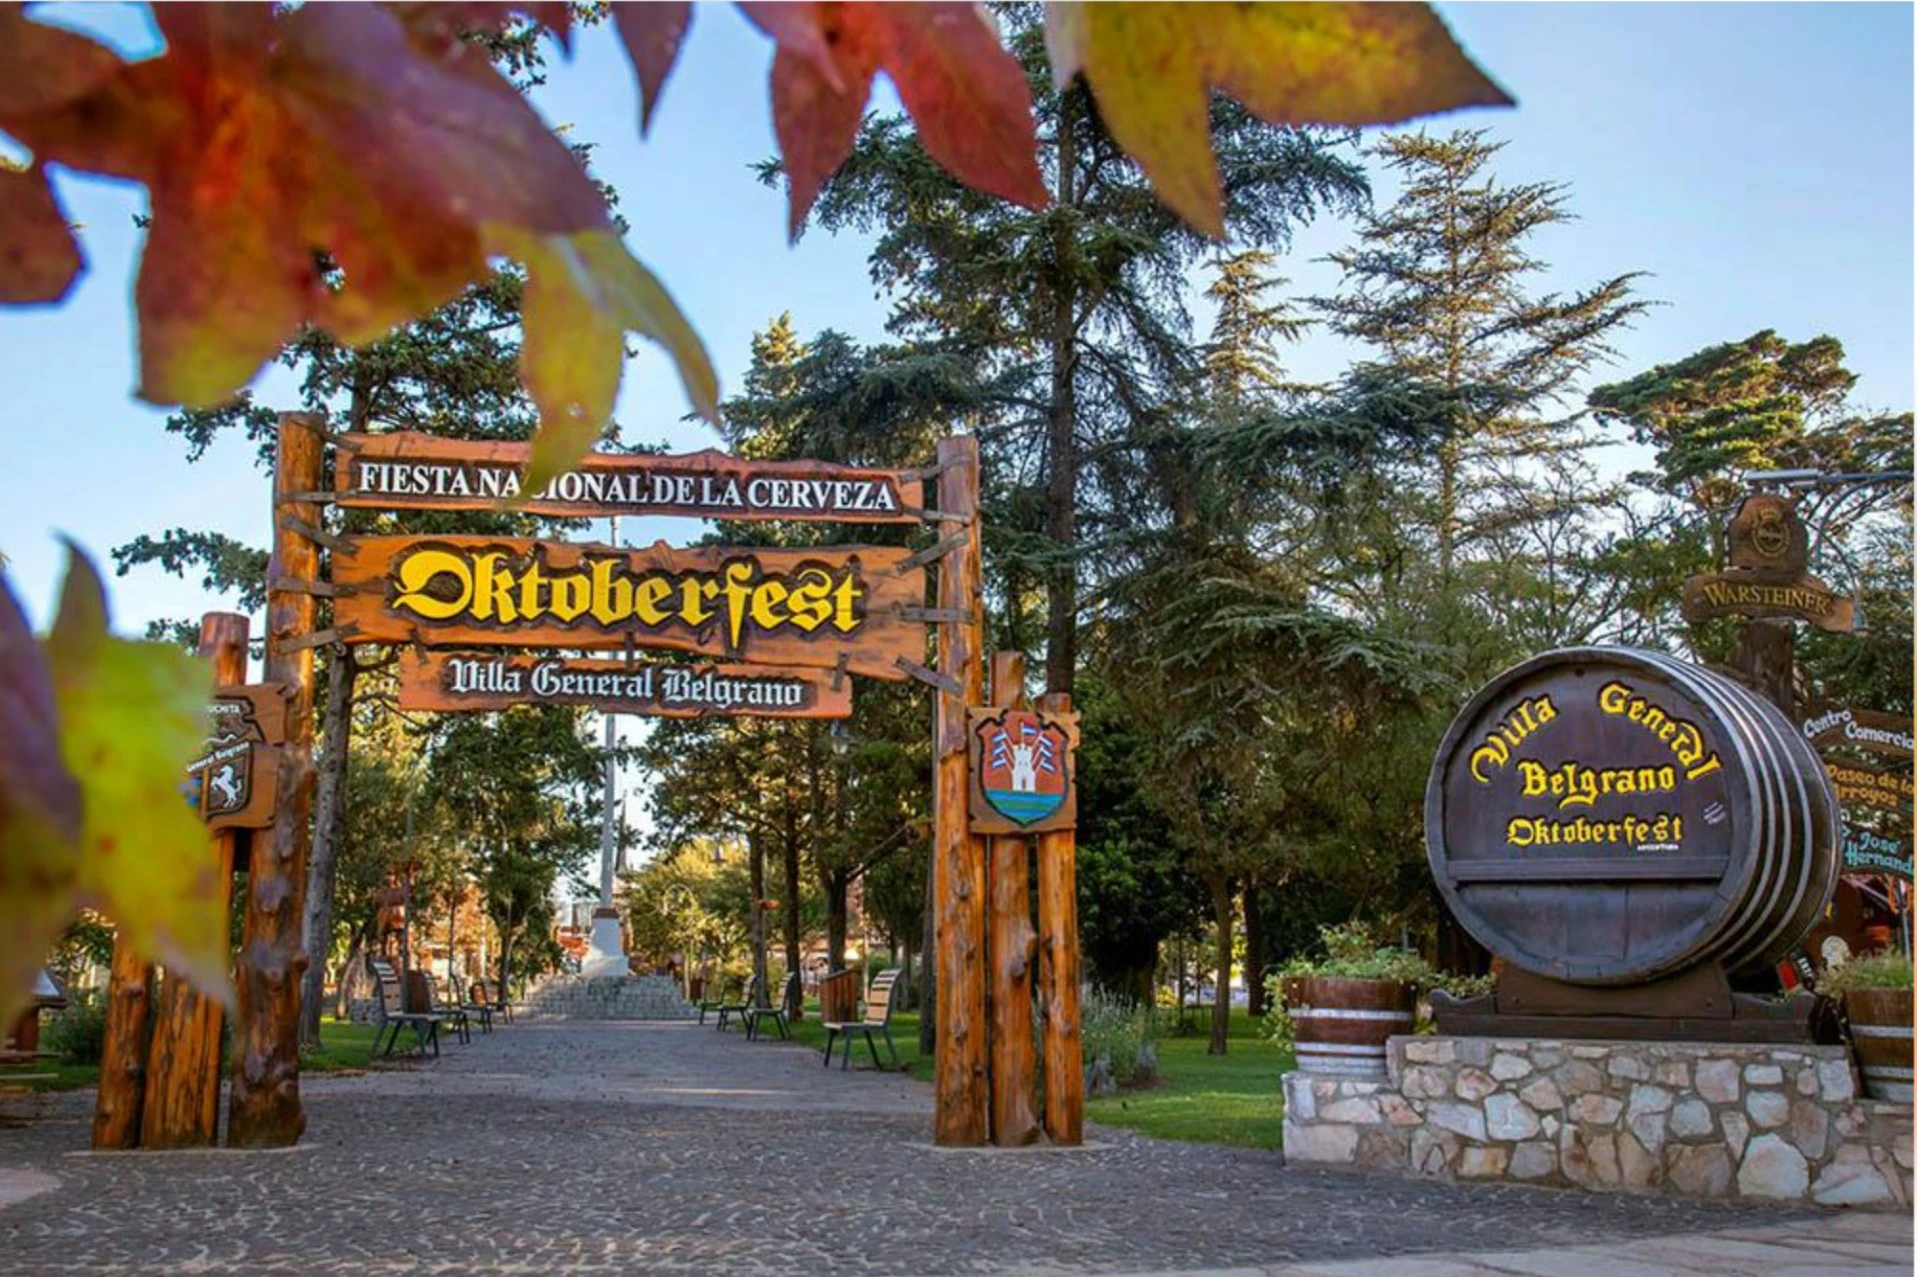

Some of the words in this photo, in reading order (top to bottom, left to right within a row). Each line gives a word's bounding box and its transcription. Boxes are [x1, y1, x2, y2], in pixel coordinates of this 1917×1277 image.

[359, 462, 471, 496] FIESTA
[477, 467, 648, 504] NAIONAL
[654, 475, 695, 504] DE
[700, 476, 743, 506] LA
[747, 478, 897, 510] CERVEZA
[392, 548, 862, 649] Oktoberfest
[1703, 581, 1831, 614] WARSTEINER
[449, 656, 521, 694] Villa
[530, 660, 653, 700] General
[662, 666, 803, 707] Belgrano
[1470, 696, 1557, 783] Villa
[1600, 683, 1722, 780] General
[1804, 710, 1851, 738] Centro
[1517, 759, 1675, 810] Belgrano
[1826, 764, 1875, 785] Paseo
[1878, 772, 1898, 789] de
[1507, 814, 1683, 847] Oktoberfest
